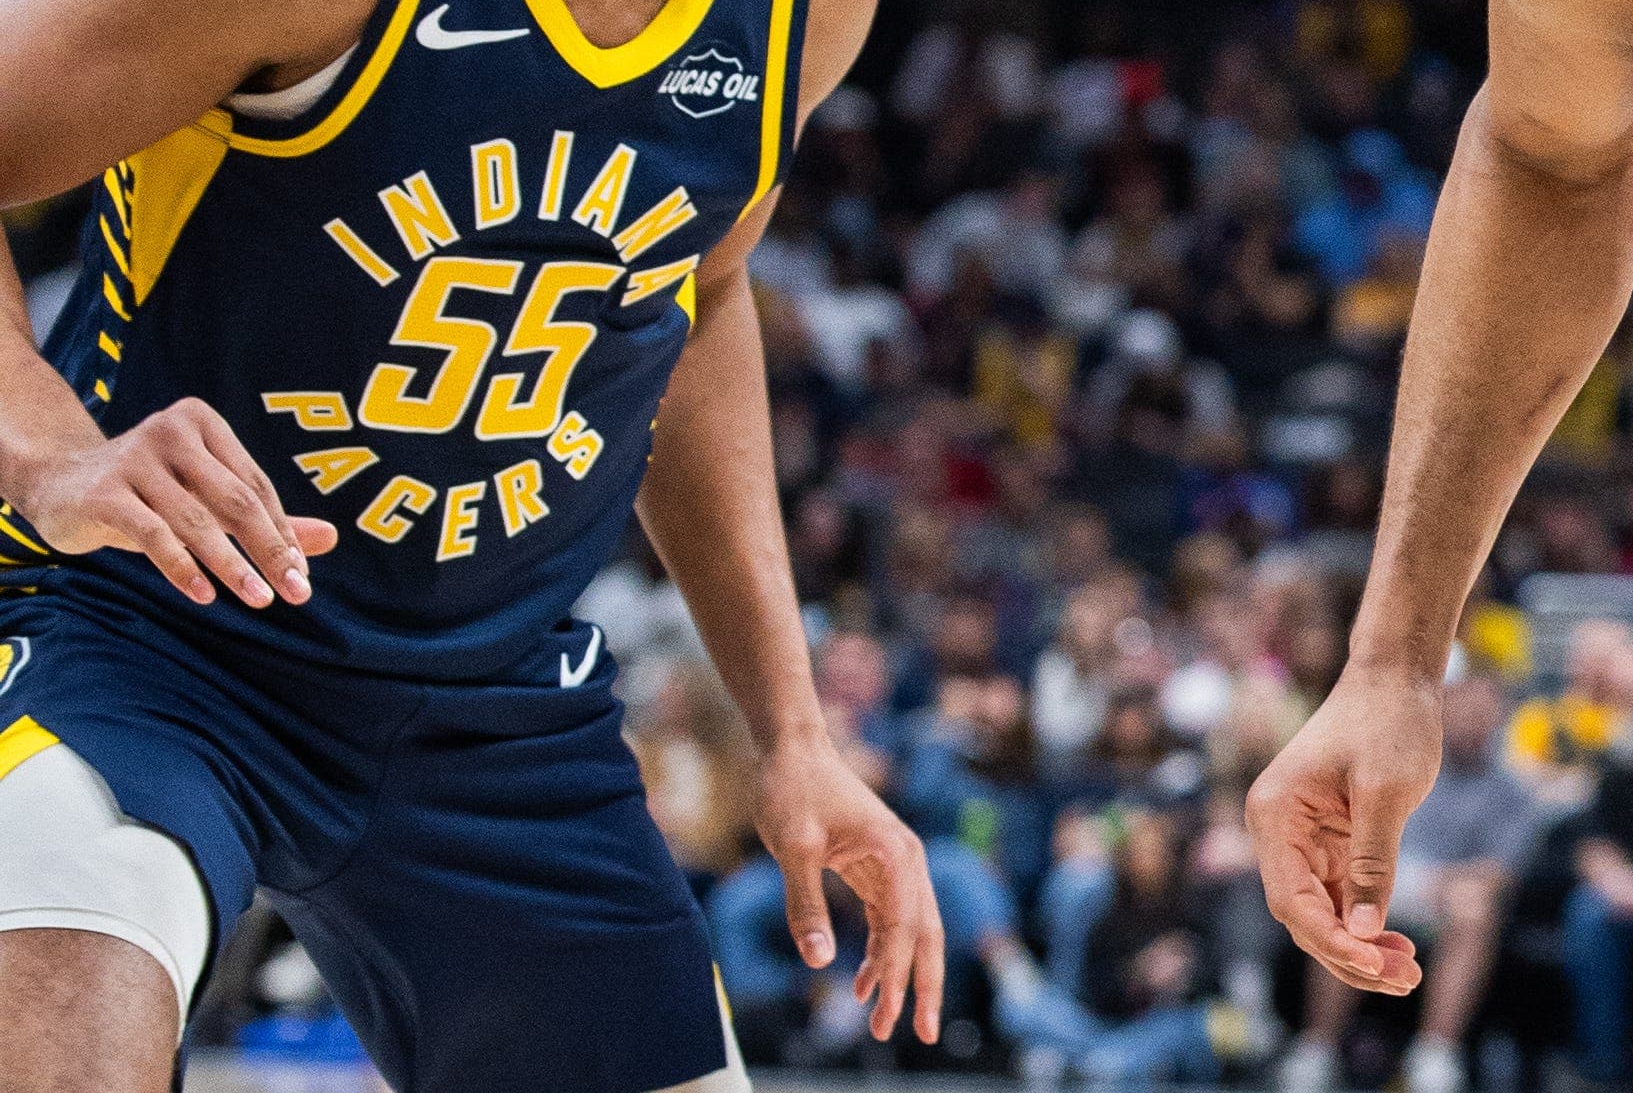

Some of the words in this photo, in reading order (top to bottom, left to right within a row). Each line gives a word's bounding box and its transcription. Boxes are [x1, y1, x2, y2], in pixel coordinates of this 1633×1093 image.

[657, 69, 723, 97] LUCAS
[722, 72, 759, 102] OIL
[323, 130, 700, 307] INDIANA
[357, 256, 627, 441] 55
[260, 390, 605, 563] PACERS
